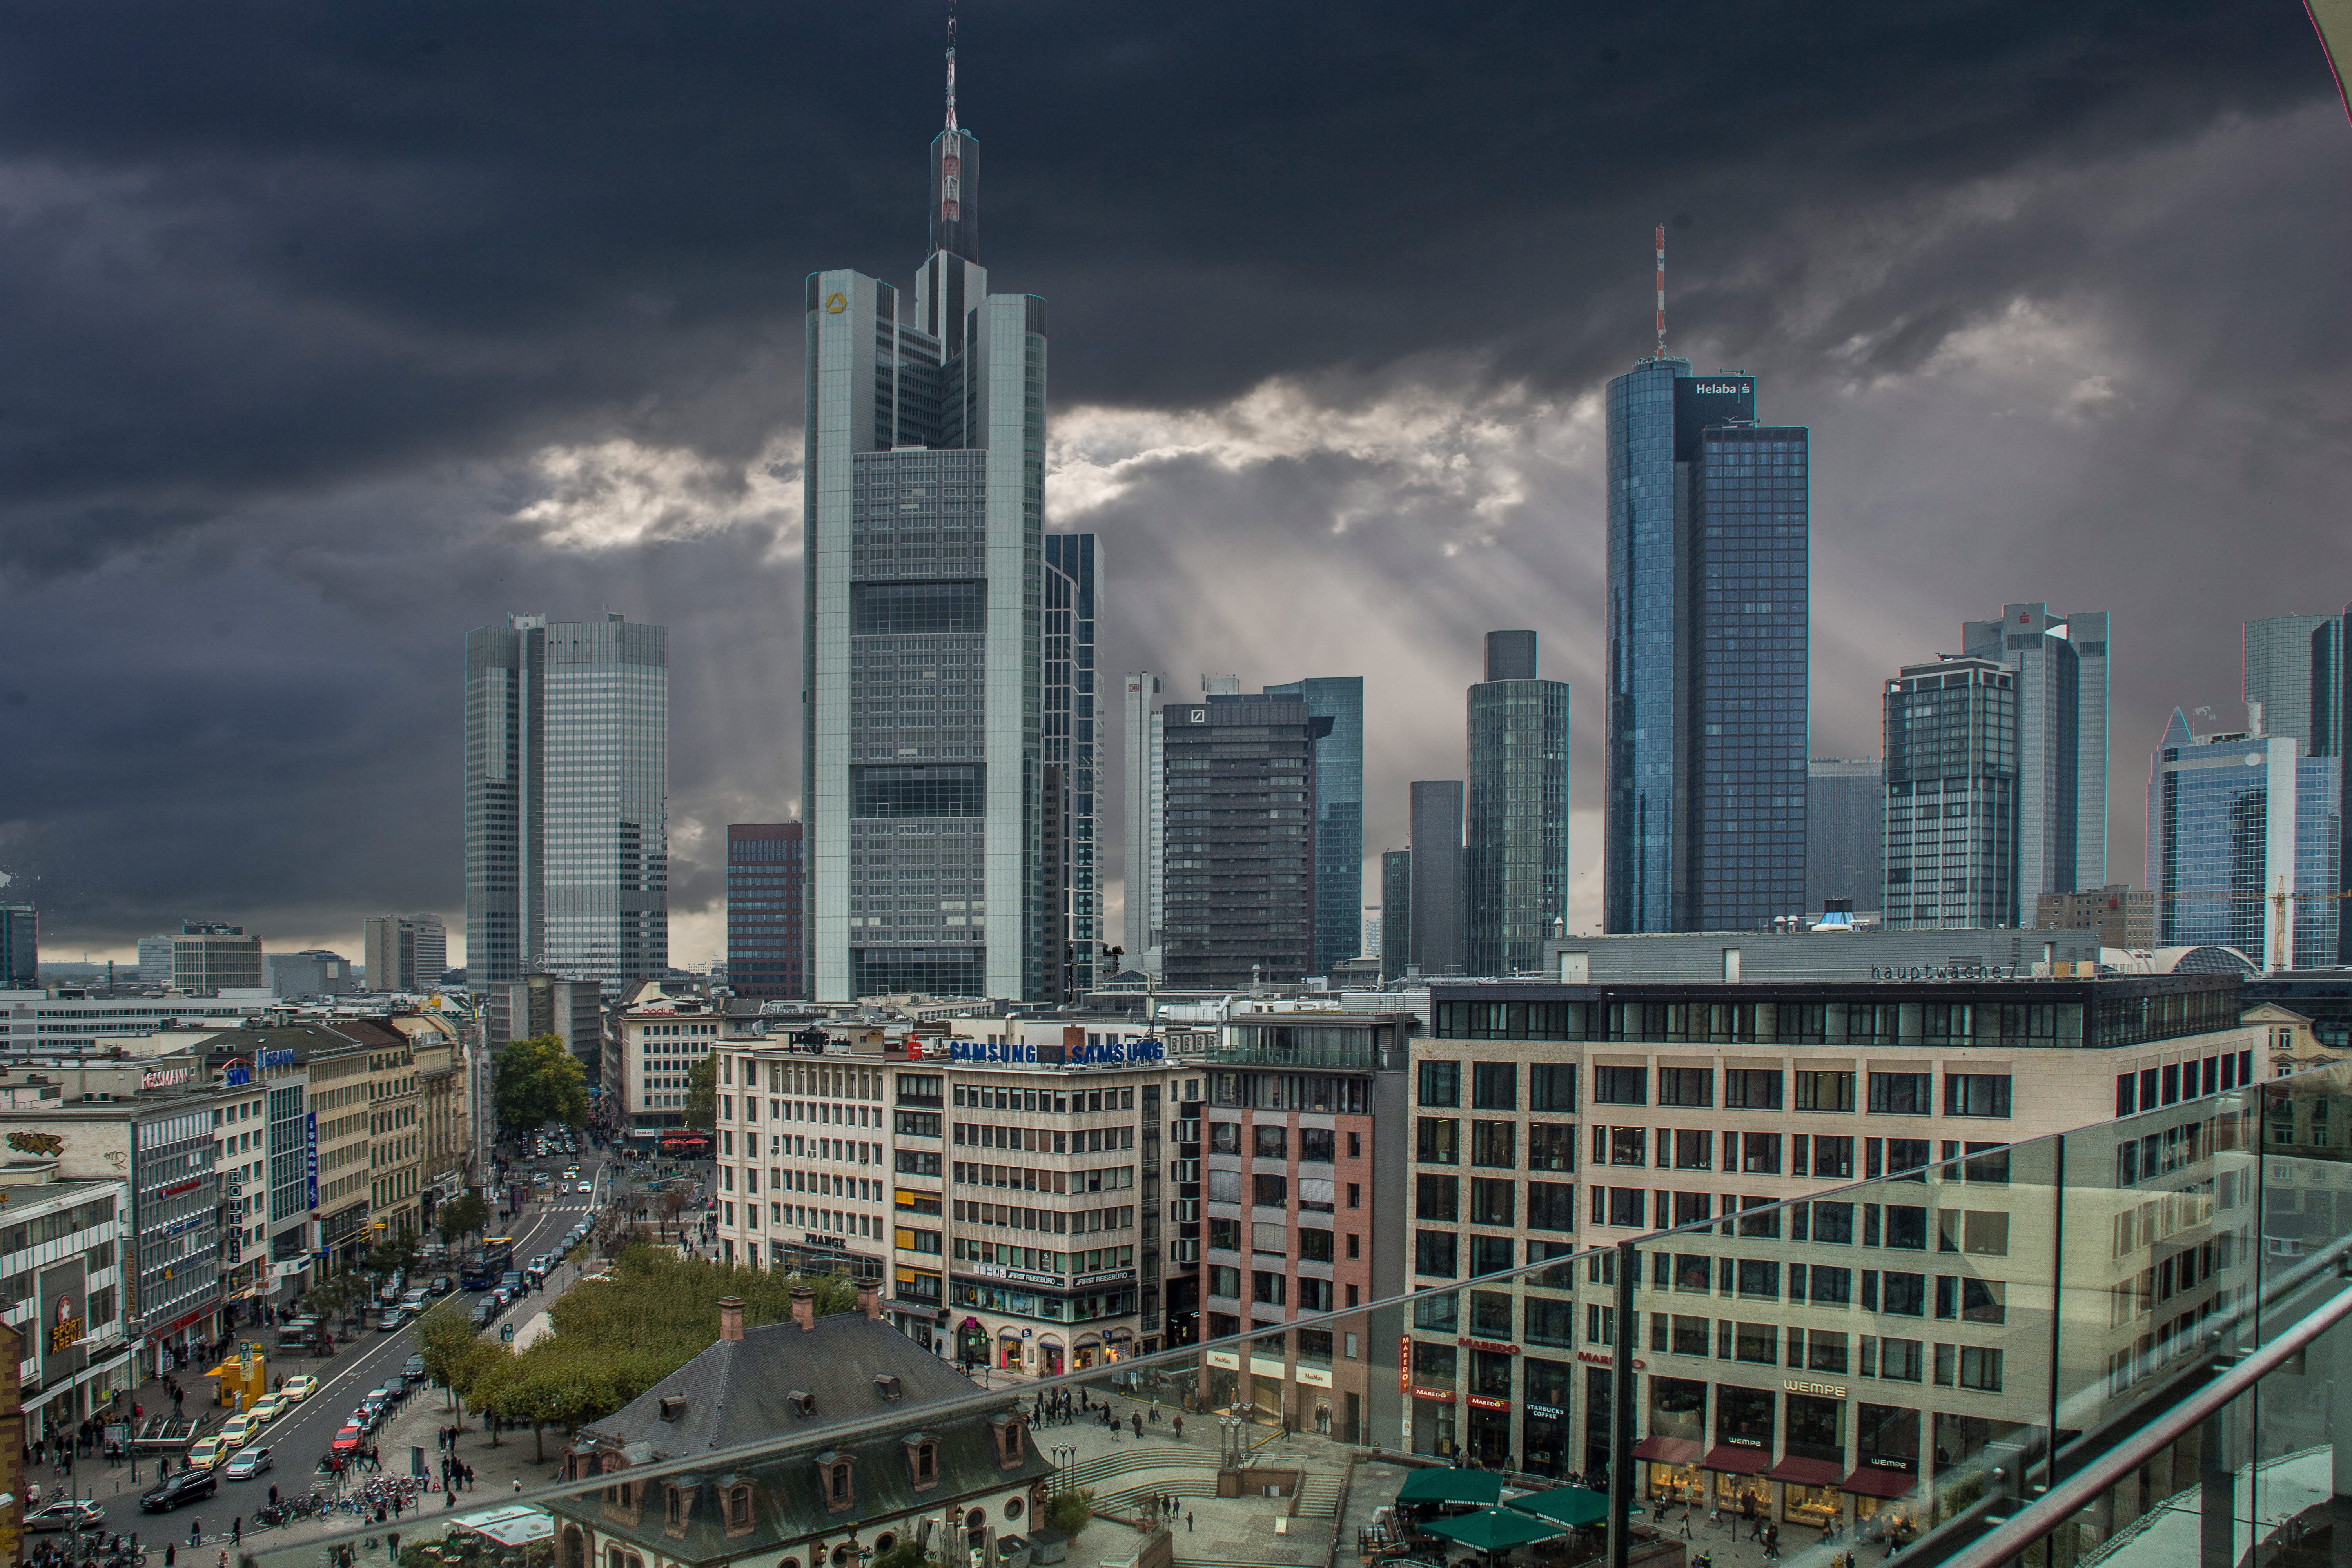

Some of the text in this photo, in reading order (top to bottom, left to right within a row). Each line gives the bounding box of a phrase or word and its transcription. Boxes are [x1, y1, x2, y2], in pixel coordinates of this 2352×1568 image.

[1696, 383, 1737, 394] Helaba
[1871, 962, 2018, 982] hauptwache 7
[642, 1007, 679, 1016] bodum
[761, 1006, 799, 1015] ASIANA
[949, 1041, 1036, 1065] SAMSUNG
[1071, 1042, 1163, 1064] SAMSUNG
[230, 1172, 241, 1238] HOTEL
[127, 1249, 135, 1312] SPORTARENA
[1026, 1274, 1056, 1285] REISEBÜRO
[1077, 1271, 1128, 1285] FIRST REISEBÜRO
[52, 1330, 82, 1354] ARENA
[505, 1333, 513, 1341] U
[1458, 1337, 1521, 1355] MAREDO
[241, 1352, 249, 1361] U
[1215, 1356, 1231, 1364] MaxMara
[1305, 1372, 1323, 1381] MaxMara
[1784, 1379, 1846, 1397] WEMPE
[1416, 1389, 1446, 1399] MAREDO
[1472, 1398, 1501, 1408] MAREDO
[1526, 1404, 1564, 1415] STARBUCKS
[1533, 1411, 1557, 1420] COFFEE
[1728, 1437, 1762, 1447] WEMPE
[1871, 1457, 1907, 1469] WEMPE
[1536, 1512, 1560, 1524] STARBUCKS
